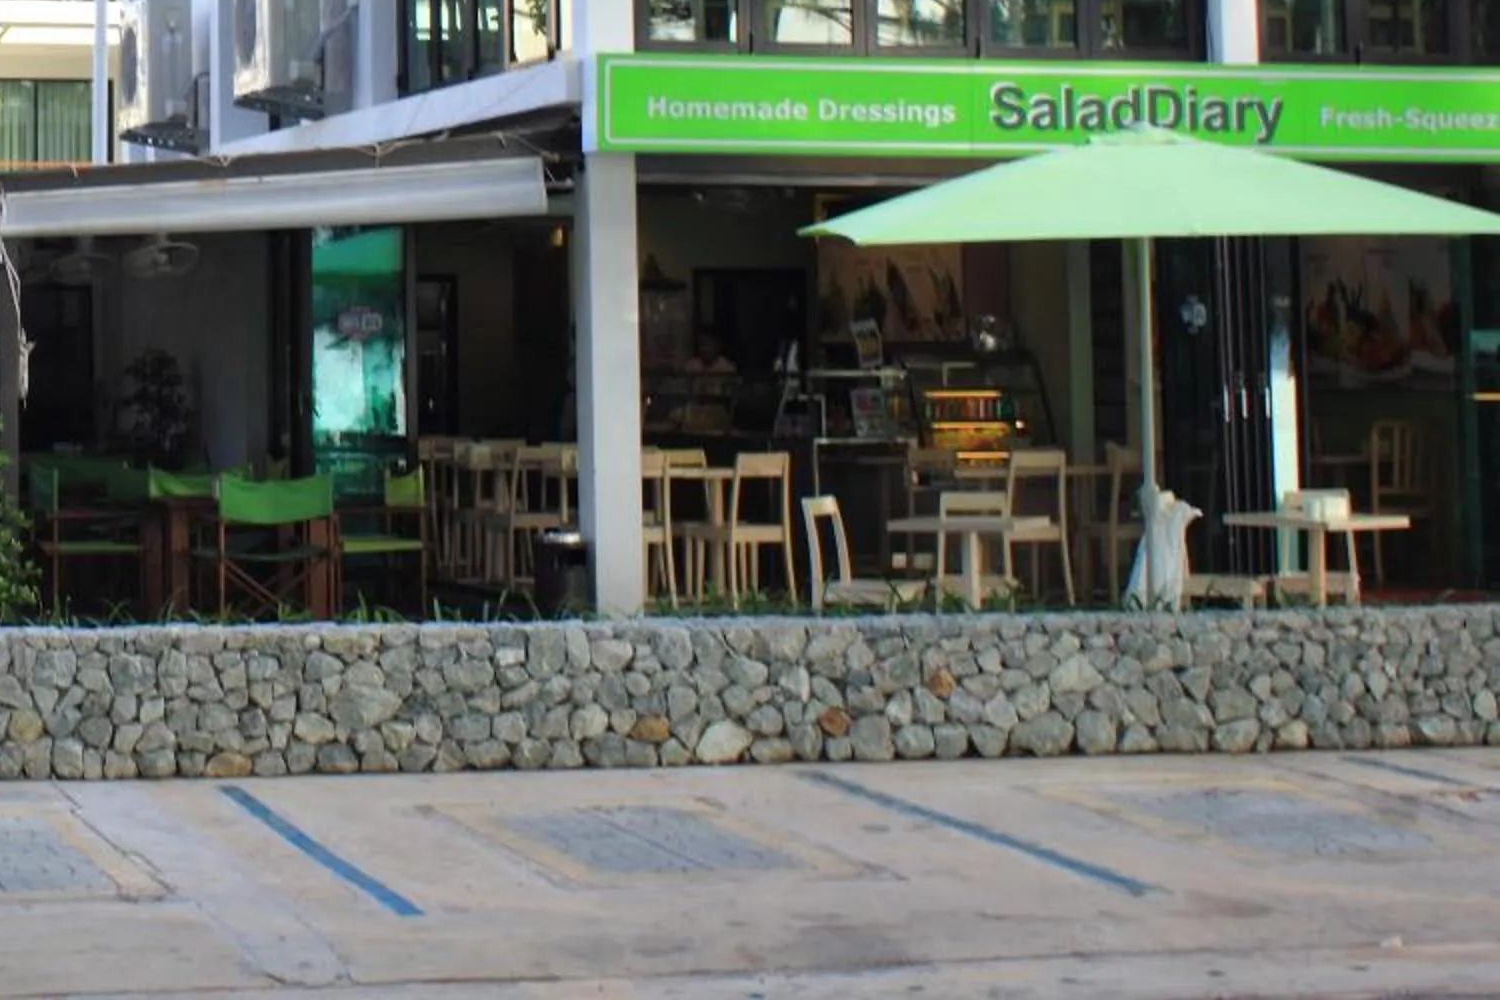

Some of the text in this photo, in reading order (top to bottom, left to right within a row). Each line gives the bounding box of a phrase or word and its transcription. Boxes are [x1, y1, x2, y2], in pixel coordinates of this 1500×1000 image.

[647, 96, 956, 128] Homemade Dressings
[989, 81, 1284, 144] SaladDiary
